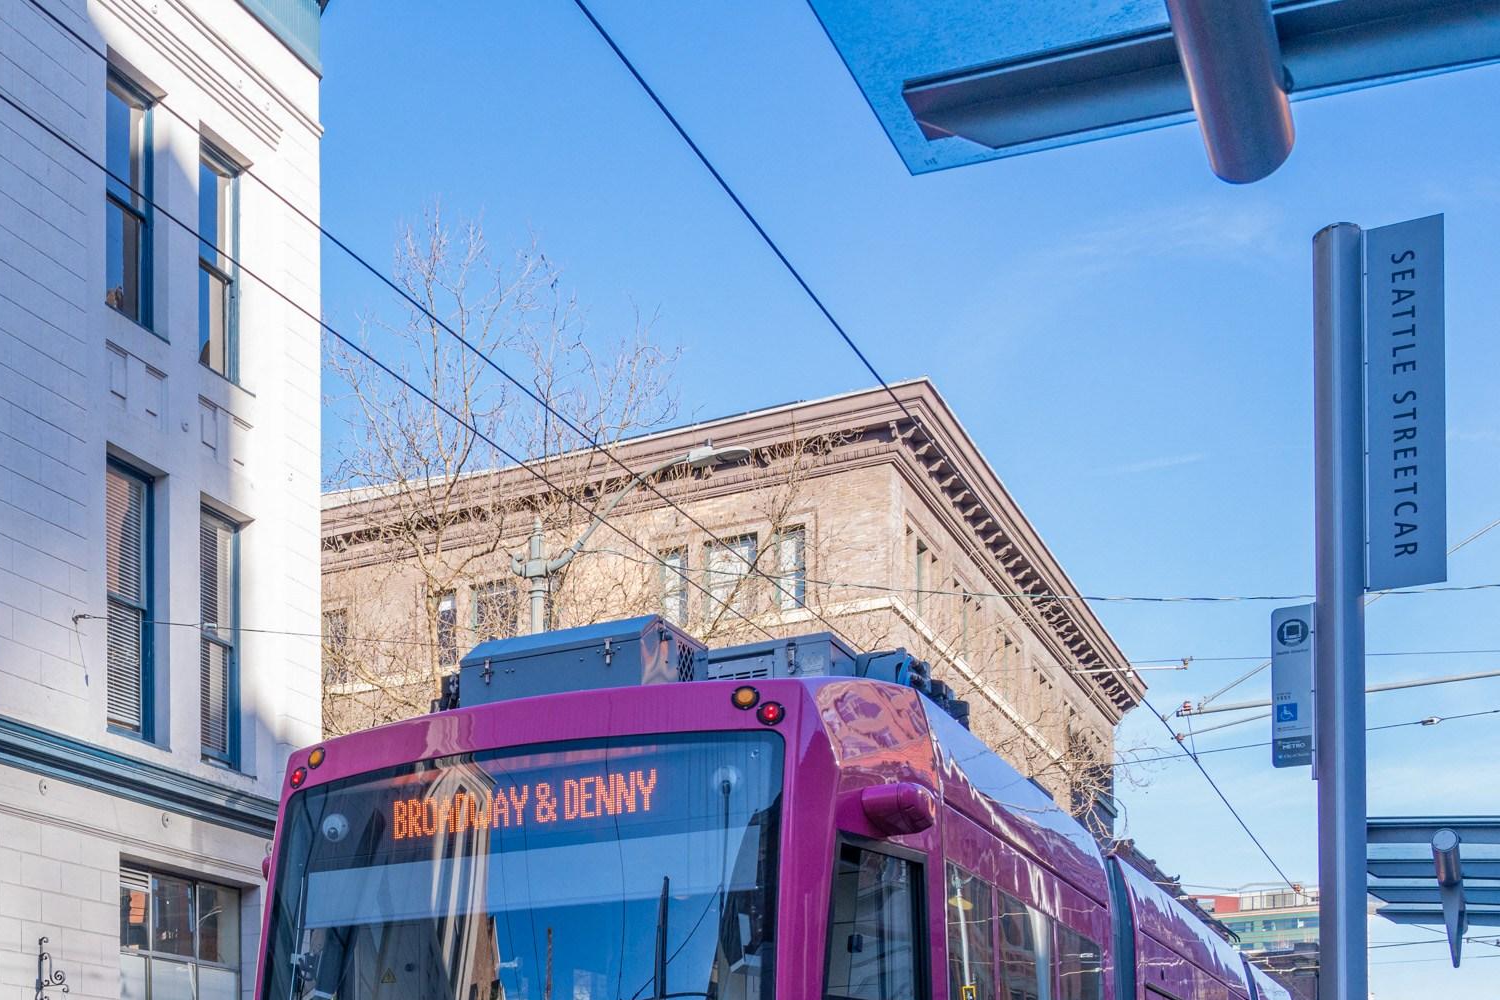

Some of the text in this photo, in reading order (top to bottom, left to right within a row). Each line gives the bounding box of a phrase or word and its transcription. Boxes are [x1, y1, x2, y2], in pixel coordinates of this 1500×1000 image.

[1391, 250, 1418, 558] SEATTLE STREETCAR
[393, 768, 657, 841] BROADWAY & DENNY
